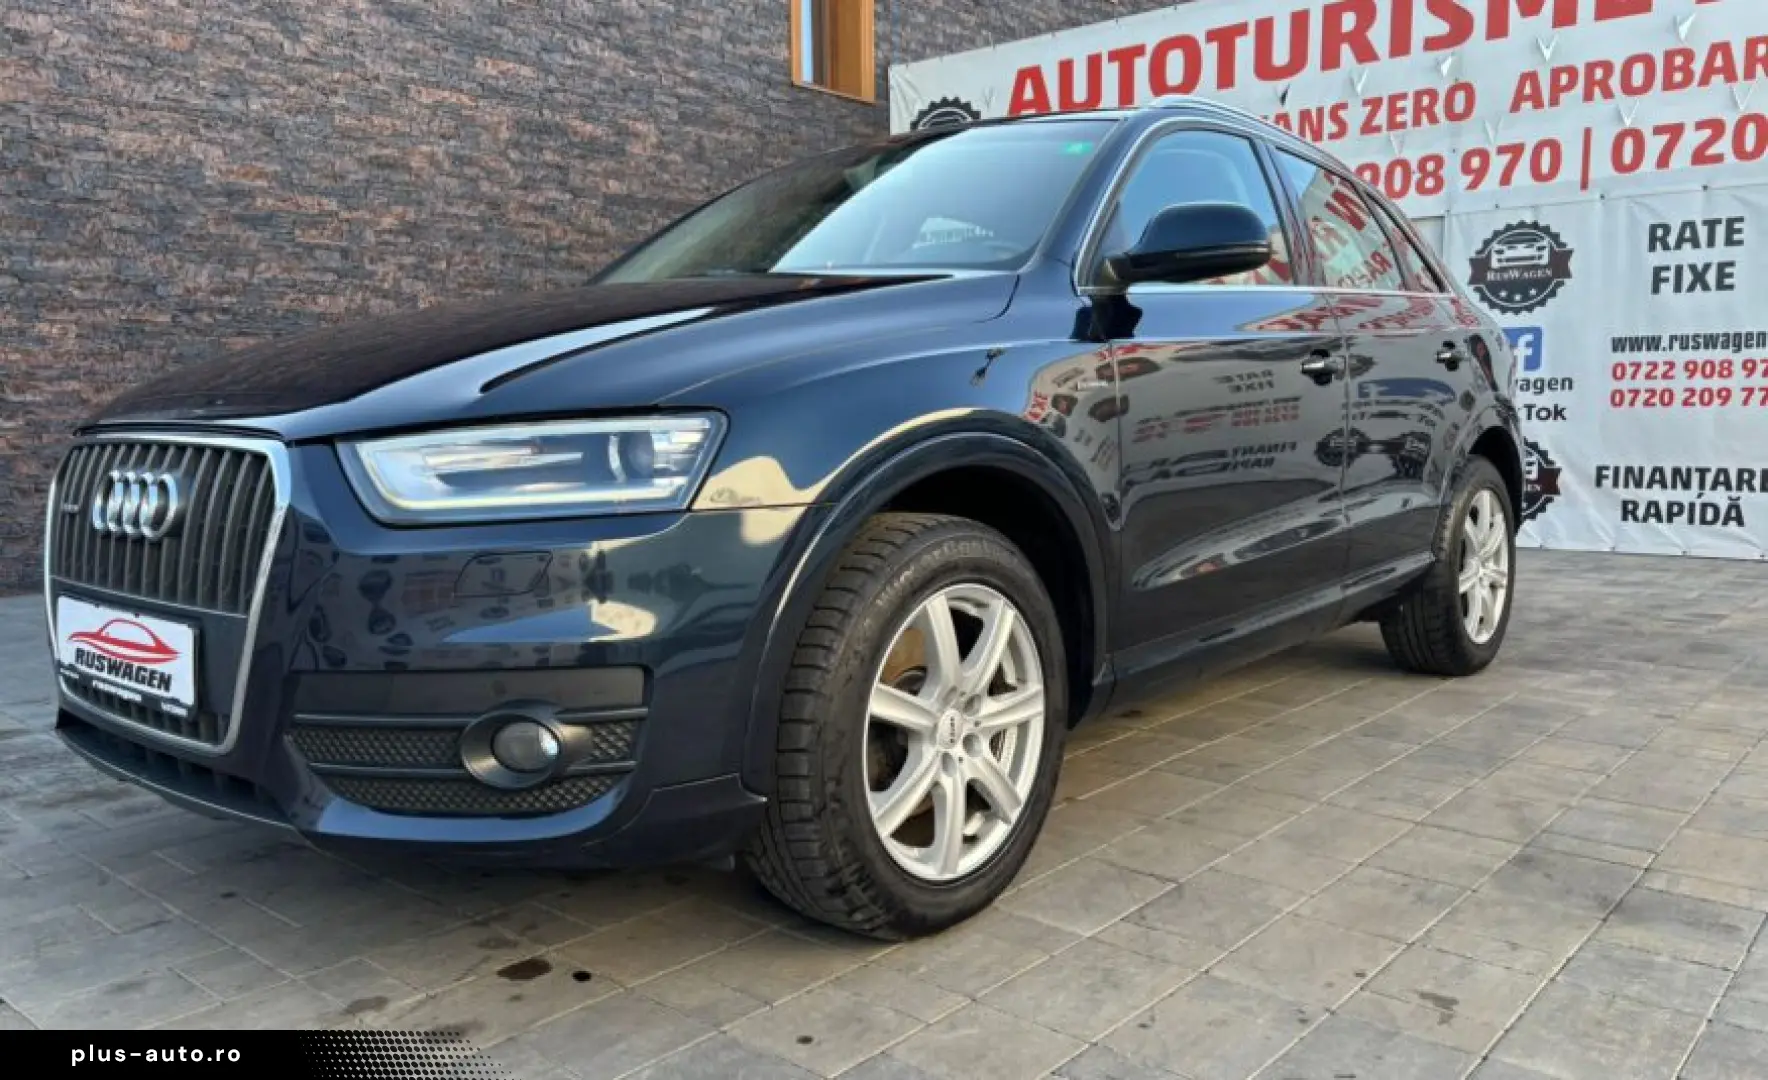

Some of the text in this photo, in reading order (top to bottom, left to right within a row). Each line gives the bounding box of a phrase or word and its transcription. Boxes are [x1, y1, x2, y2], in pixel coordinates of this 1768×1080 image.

[1008, 0, 1653, 117] AUTOTURISM
[1360, 81, 1476, 136] ZERO
[1510, 35, 1768, 114] APROBAR
[1460, 138, 1563, 191] 970
[1611, 112, 1768, 175] 0720
[1648, 216, 1744, 252] RATE
[1651, 261, 1735, 294] FIXE
[1516, 376, 1573, 395] agen
[1612, 360, 1676, 381] 0722
[1684, 358, 1734, 380] 908
[1523, 403, 1567, 421] Tok
[1610, 387, 1675, 408] 0720
[1681, 386, 1732, 408] 209
[75, 647, 173, 693] RUSWAGEN
